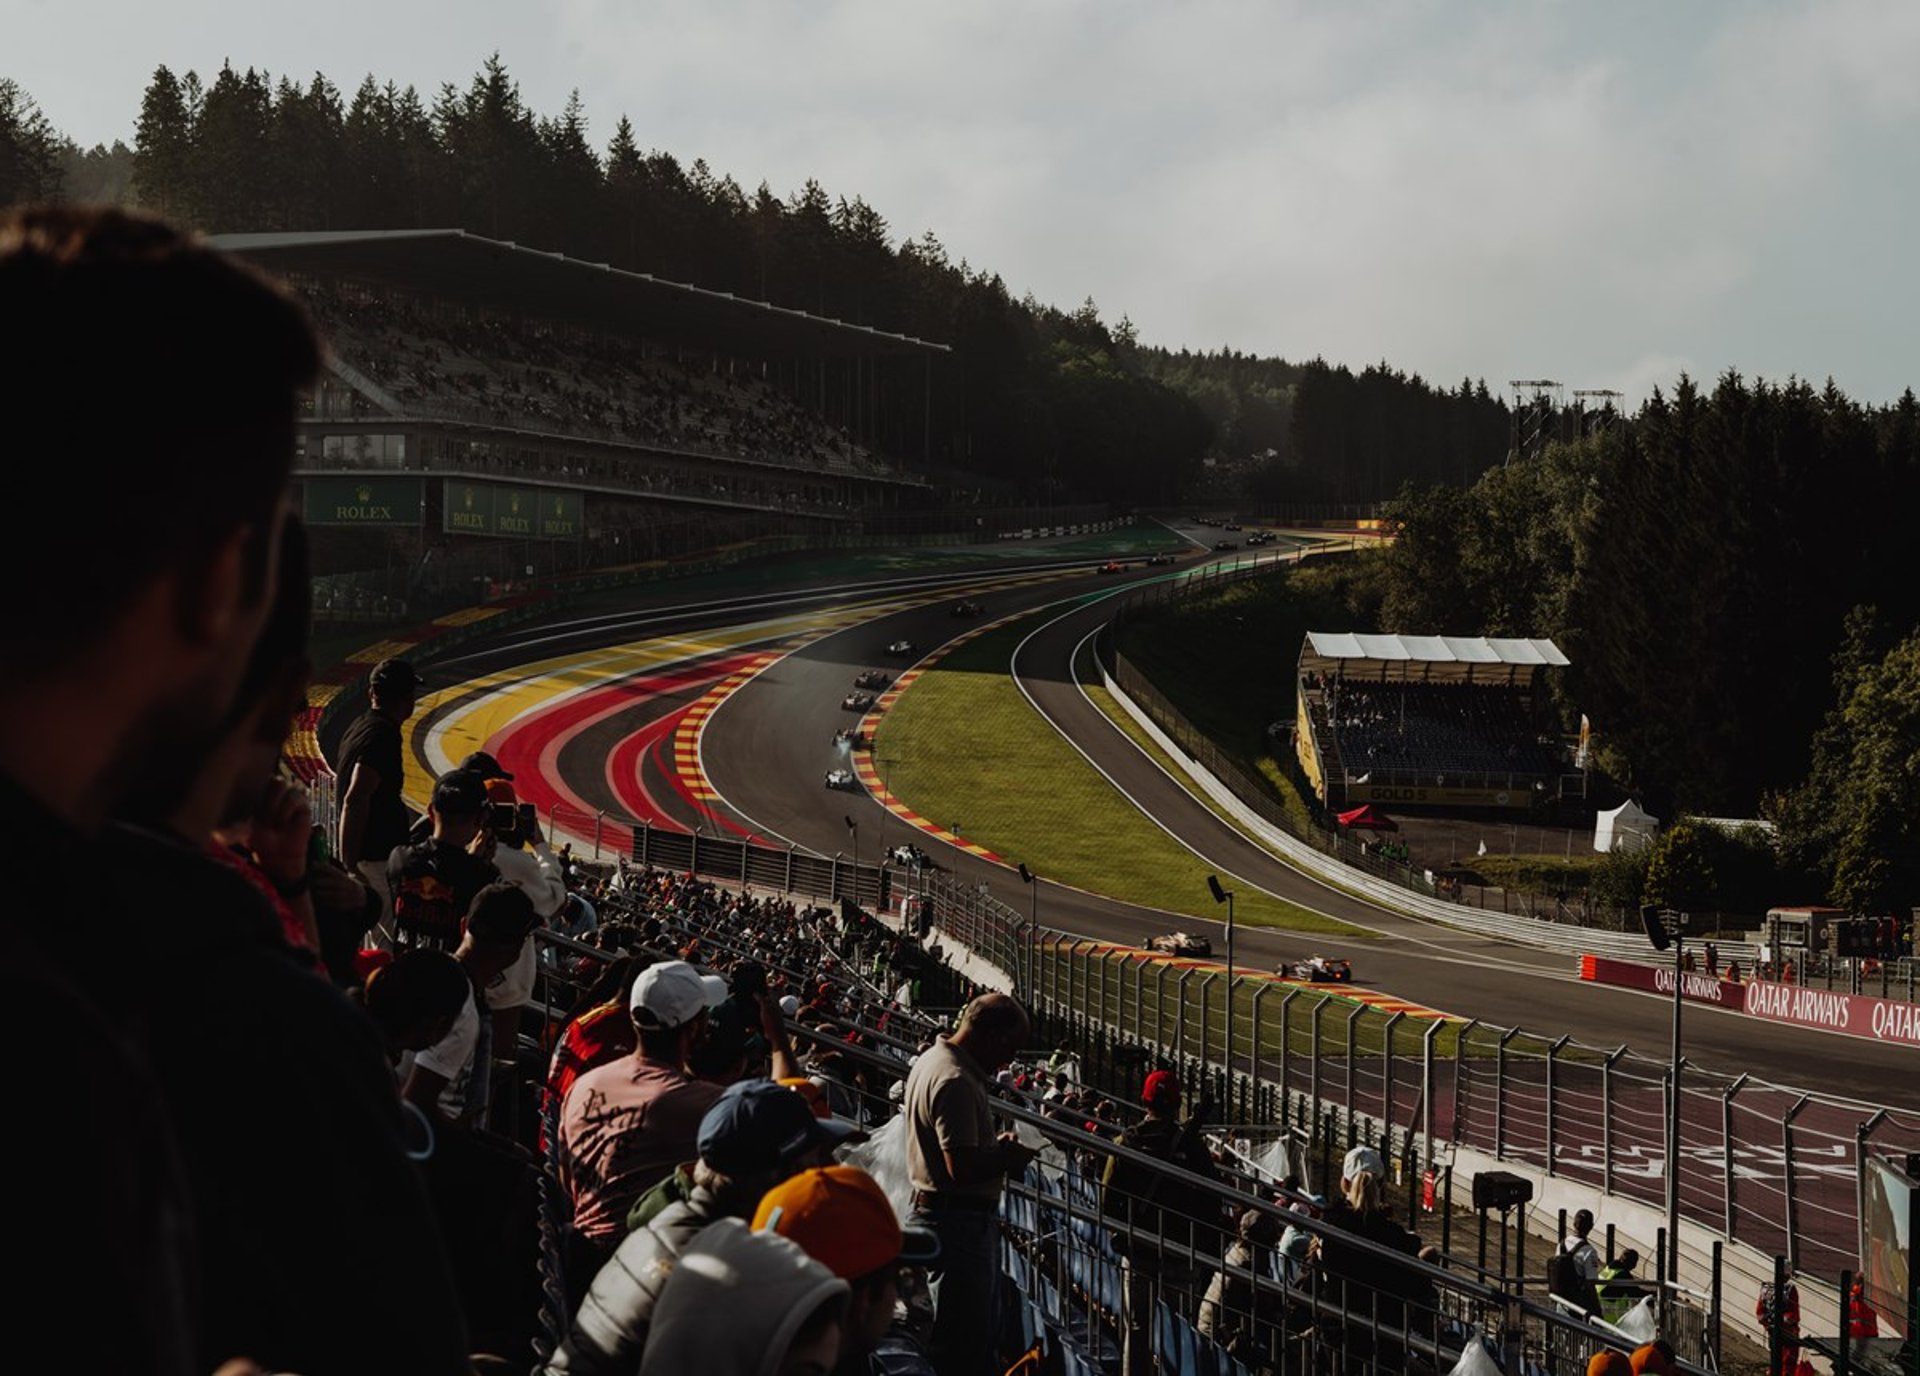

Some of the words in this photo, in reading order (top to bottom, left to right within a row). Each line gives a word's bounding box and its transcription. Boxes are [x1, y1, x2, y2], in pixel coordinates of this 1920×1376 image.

[336, 506, 392, 520] ROLEX
[453, 511, 484, 528] ROLEX
[499, 516, 528, 533] ROLEX
[1370, 788, 1414, 801] GOLD
[1417, 790, 1428, 801] 5
[1654, 968, 1685, 994] QATR
[1686, 975, 1722, 1001] AIRWAYS
[1747, 982, 1789, 1017] QATAR
[1790, 988, 1850, 1028] AIRWAYS
